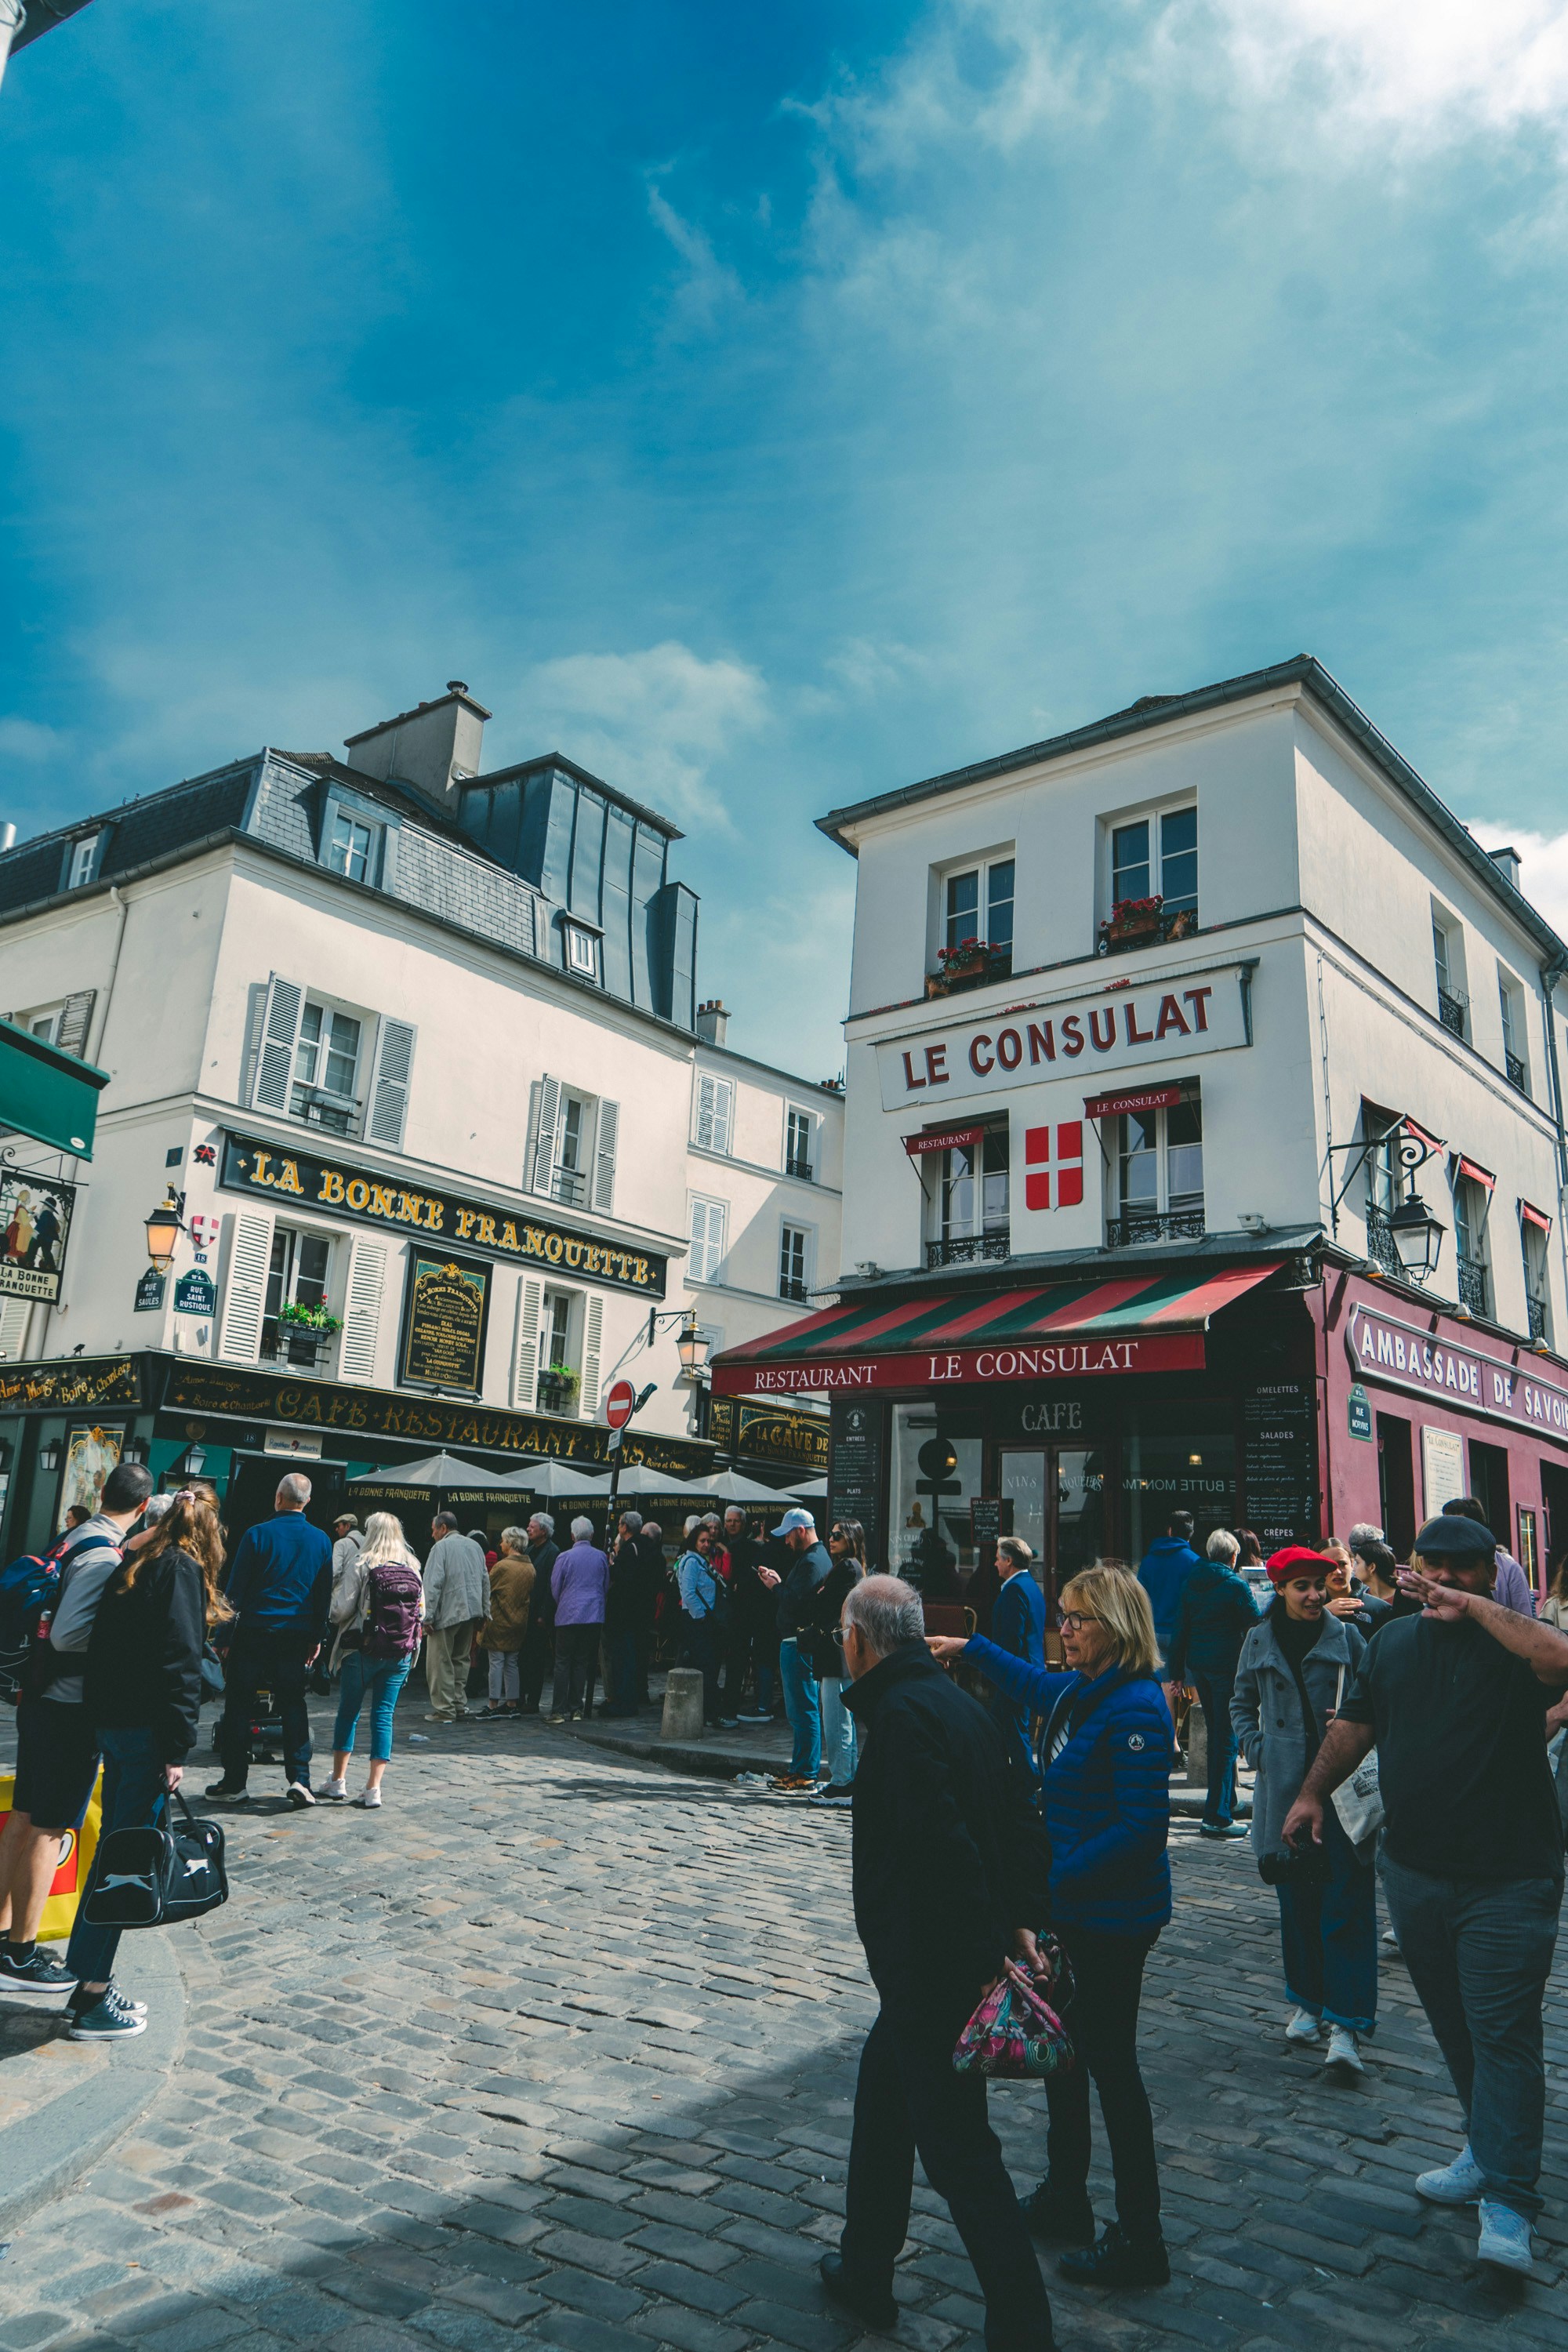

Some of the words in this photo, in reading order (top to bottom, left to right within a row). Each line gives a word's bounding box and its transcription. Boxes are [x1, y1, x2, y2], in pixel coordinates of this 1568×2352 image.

[902, 1044, 950, 1091] LE
[969, 986, 1213, 1077] CONSULAT
[1096, 1103, 1109, 1113] LE
[1112, 1093, 1168, 1111] CONSULAT
[918, 1133, 972, 1150] RESTAURANT
[249, 1150, 304, 1195] LA
[318, 1169, 445, 1231] BONNE
[455, 1207, 649, 1284] FRANQUETTE
[0, 1267, 13, 1278] LA
[17, 1270, 49, 1285] BONNE
[145, 1283, 157, 1291] RUE
[190, 1286, 203, 1294] RUE
[138, 1297, 159, 1306] SAULES
[187, 1294, 206, 1302] SAINT
[447, 1287, 478, 1313] FRANQUETTE
[180, 1300, 212, 1312] RUSTIQUE
[754, 1365, 877, 1389] RESTAURANT
[928, 1355, 963, 1380] LE
[976, 1342, 1138, 1377] CONSULAT
[1362, 1323, 1479, 1397] AMBASSADE
[1493, 1373, 1512, 1408] DE
[60, 1382, 88, 1403] Boire
[86, 1388, 96, 1403] et
[1257, 1385, 1298, 1394] OMELETTES
[1021, 1403, 1082, 1431] CAFE
[1356, 1406, 1364, 1417] RUE
[381, 1400, 582, 1457] RESTAURANT
[1352, 1419, 1369, 1432] NORVINS
[757, 1425, 768, 1441] LA
[771, 1425, 812, 1451] CAVE
[816, 1436, 829, 1451] DE
[1007, 1475, 1036, 1489] VINS
[359, 1488, 383, 1497] BONNE
[385, 1488, 430, 1501] FRANQUETTE
[448, 1493, 459, 1503] LA
[460, 1493, 485, 1502] BONNE
[485, 1493, 531, 1504] FRANQUETTE
[559, 1501, 568, 1511] LA
[569, 1501, 590, 1509] BONNE
[592, 1500, 631, 1509] FRANETTE
[659, 1498, 679, 1508] BONNE
[680, 1498, 717, 1508] FRANQUETTE
[1264, 1528, 1294, 1537] CRÊPES
